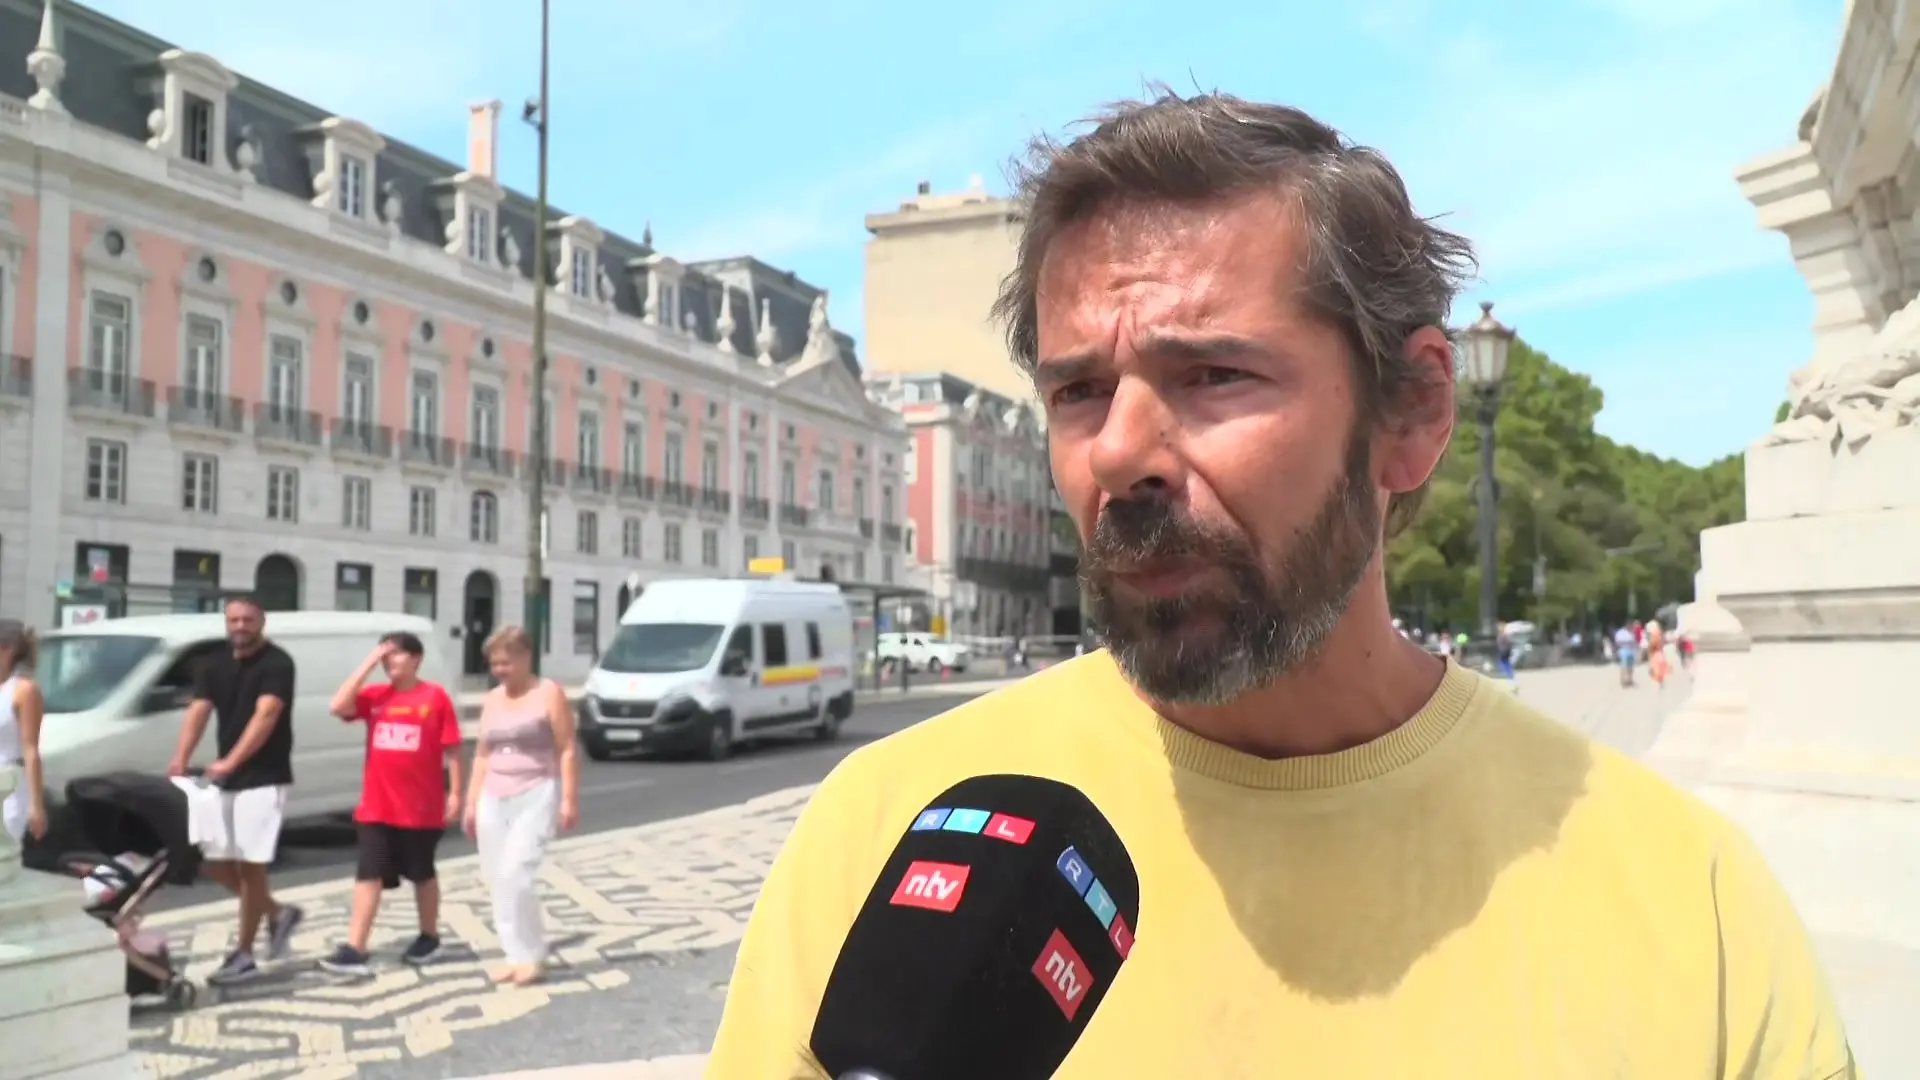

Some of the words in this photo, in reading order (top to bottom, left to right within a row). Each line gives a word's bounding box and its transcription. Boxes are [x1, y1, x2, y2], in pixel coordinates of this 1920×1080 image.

[918, 811, 1018, 839] RTL
[903, 869, 960, 901] ntv
[1064, 856, 1123, 949] RTL
[1044, 949, 1083, 1002] ntv
